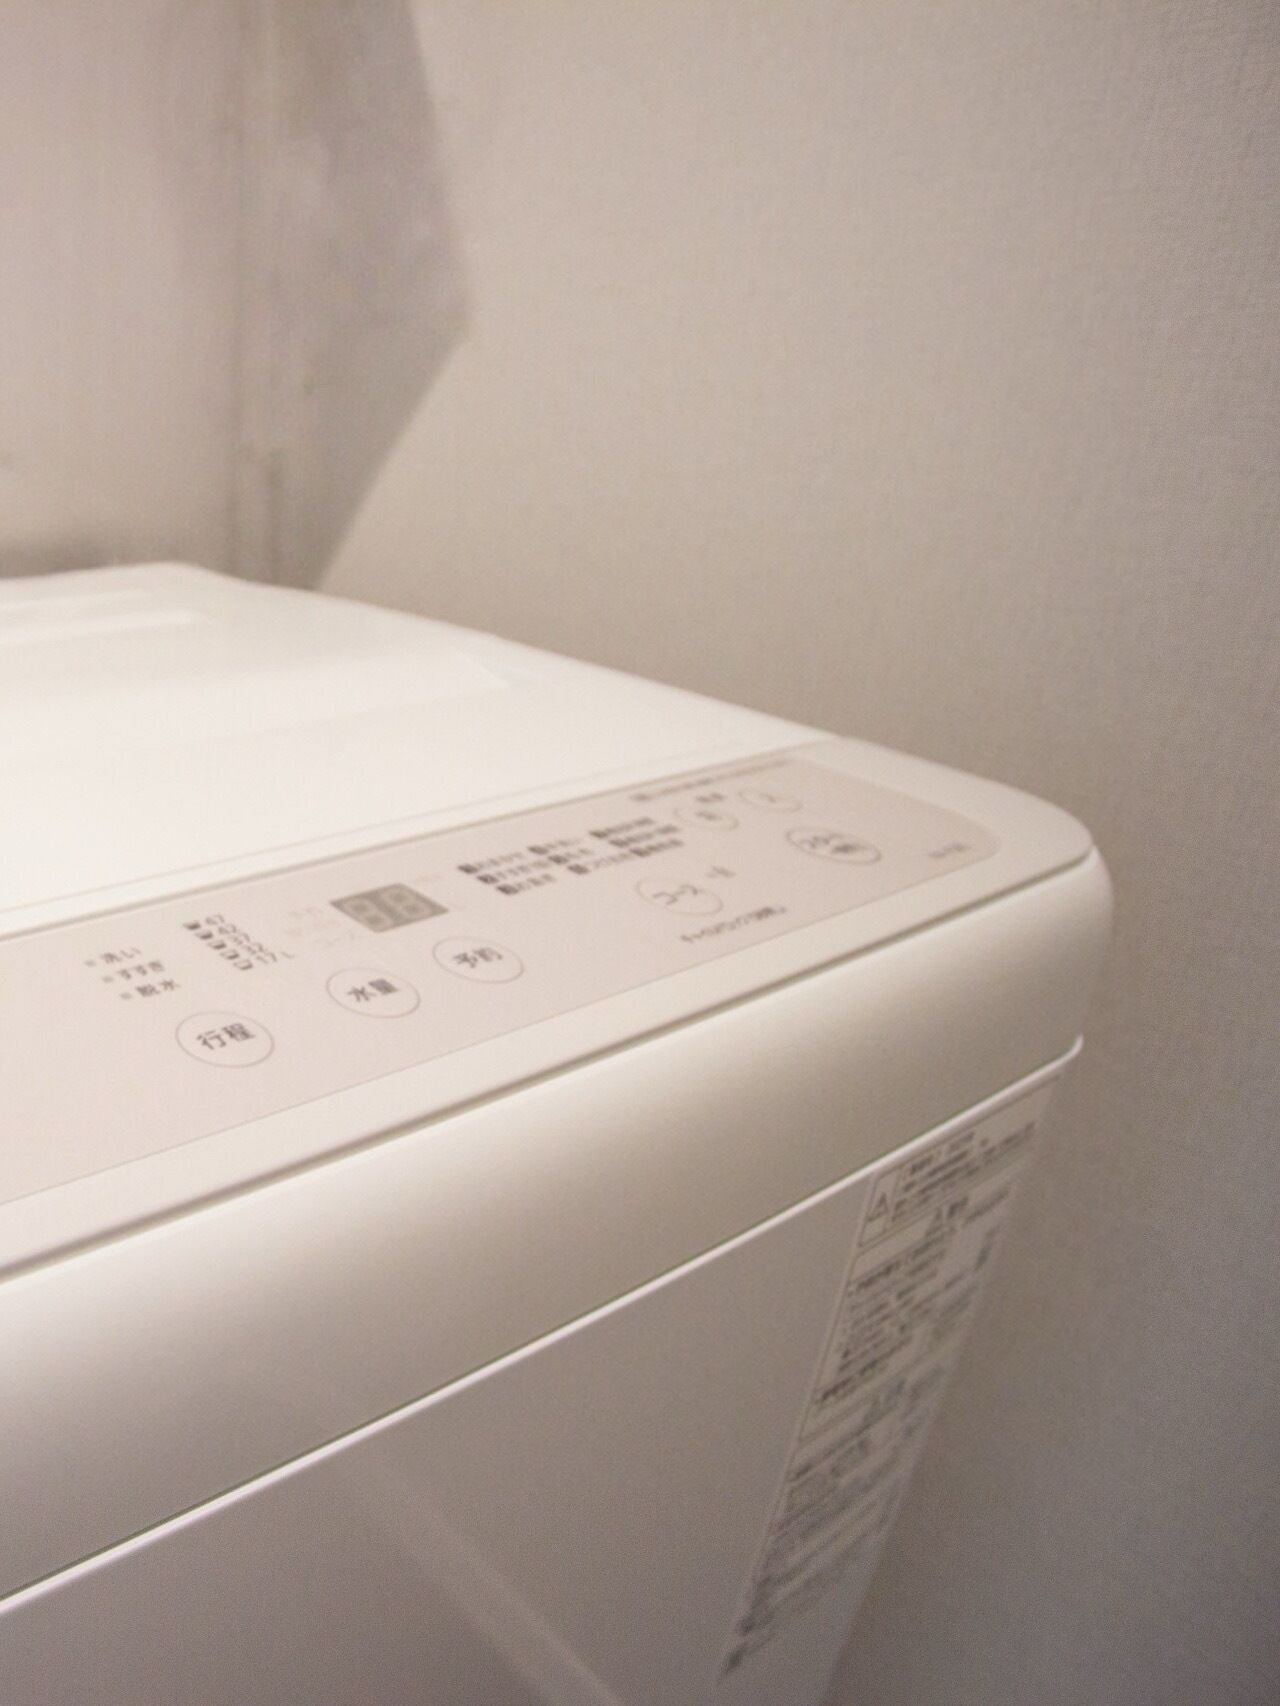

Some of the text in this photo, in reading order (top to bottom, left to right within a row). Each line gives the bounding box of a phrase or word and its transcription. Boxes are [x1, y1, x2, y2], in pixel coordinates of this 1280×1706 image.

[452, 946, 504, 969] 予約
[347, 978, 400, 1002] 水量
[195, 1022, 256, 1051] 行程
